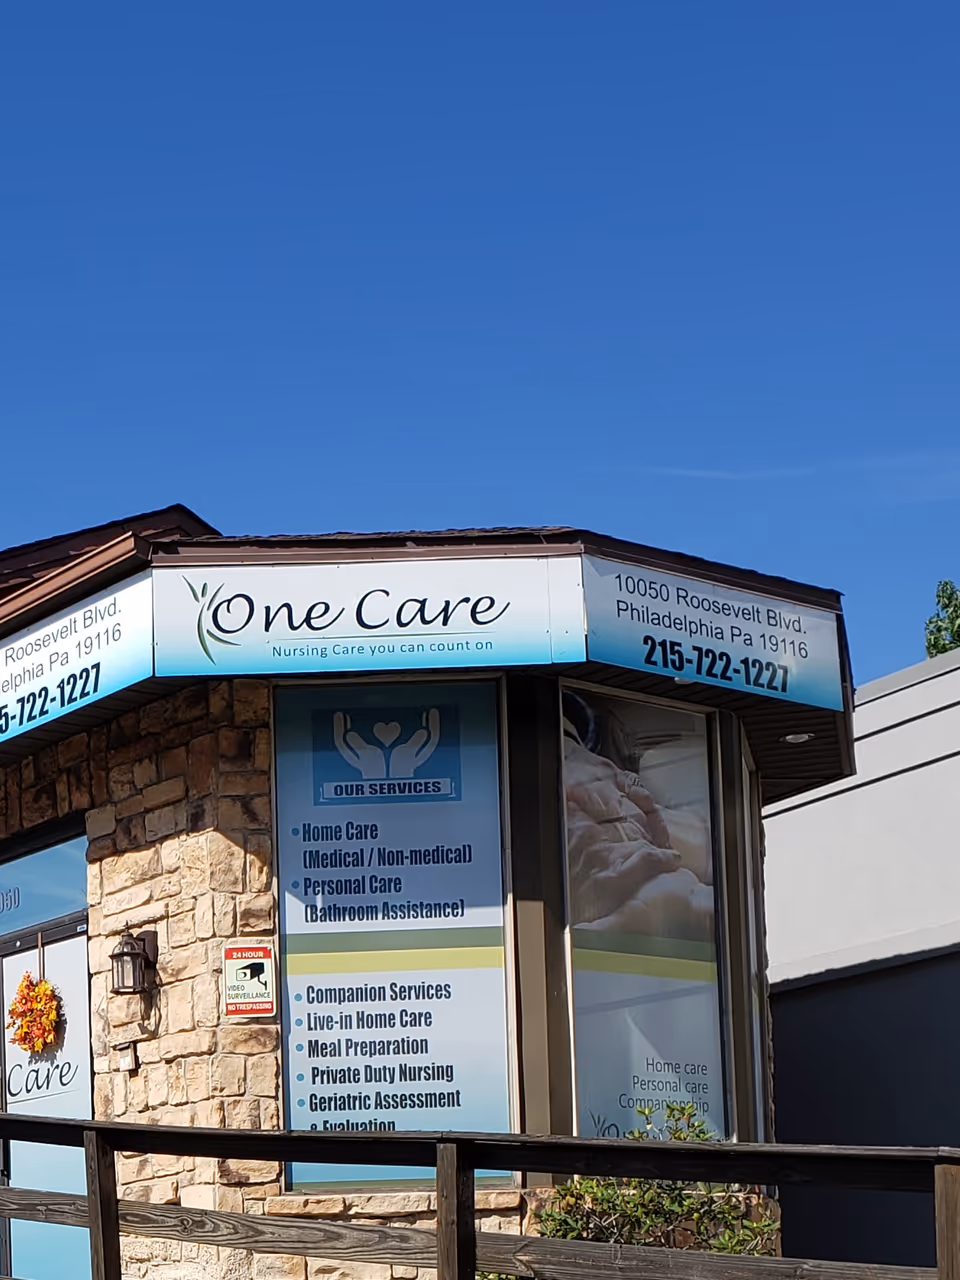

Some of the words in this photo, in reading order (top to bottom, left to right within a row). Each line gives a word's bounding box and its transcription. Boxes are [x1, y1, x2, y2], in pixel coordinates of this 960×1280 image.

[211, 593, 345, 634] One
[355, 588, 511, 629] Care
[615, 574, 670, 602] 10050
[676, 587, 762, 623] Roosevelt
[766, 609, 807, 634] Blvd.
[5, 616, 78, 666] Roosevelt
[83, 596, 122, 629] Blvd.
[616, 599, 725, 640] Philadelphia
[731, 625, 753, 646] Pa
[759, 633, 809, 659] 19116
[49, 651, 69, 672] Pa
[75, 622, 122, 659] 19116
[272, 645, 328, 659] Nursing
[332, 644, 365, 655] Care
[369, 645, 395, 656] you
[400, 643, 424, 653] can
[429, 641, 471, 652] count
[475, 641, 493, 650] on
[642, 635, 789, 693] 215-722-1227
[333, 783, 365, 796] OUR
[368, 781, 442, 795] SERVICES
[302, 822, 343, 842] Home
[345, 821, 379, 840] Care
[303, 847, 365, 869] (Medical
[367, 847, 375, 868] /
[377, 844, 473, 867] Non-medical)
[303, 875, 366, 896] Personal
[369, 874, 402, 894] Care
[304, 903, 379, 923] (Bathroom
[381, 899, 465, 921] Assistance)
[227, 984, 245, 992] VIDEO
[227, 992, 271, 1000] SURVEILLANCE
[306, 983, 387, 1005] Companion
[389, 981, 452, 1001] Services
[307, 1011, 353, 1031] Live-in
[356, 1010, 396, 1030] Home
[399, 1008, 433, 1028] Care
[307, 1038, 342, 1058] Meal
[345, 1036, 429, 1058] Preparation
[311, 1066, 361, 1085] Private
[364, 1064, 396, 1085] Duty
[399, 1063, 454, 1083] Nursing
[646, 1057, 681, 1073] Home
[684, 1062, 708, 1076] care
[7, 1061, 79, 1097] Care
[632, 1075, 682, 1092] Personal
[685, 1081, 709, 1094] care
[309, 1092, 371, 1112] Geriatric
[374, 1090, 461, 1110] Assessment
